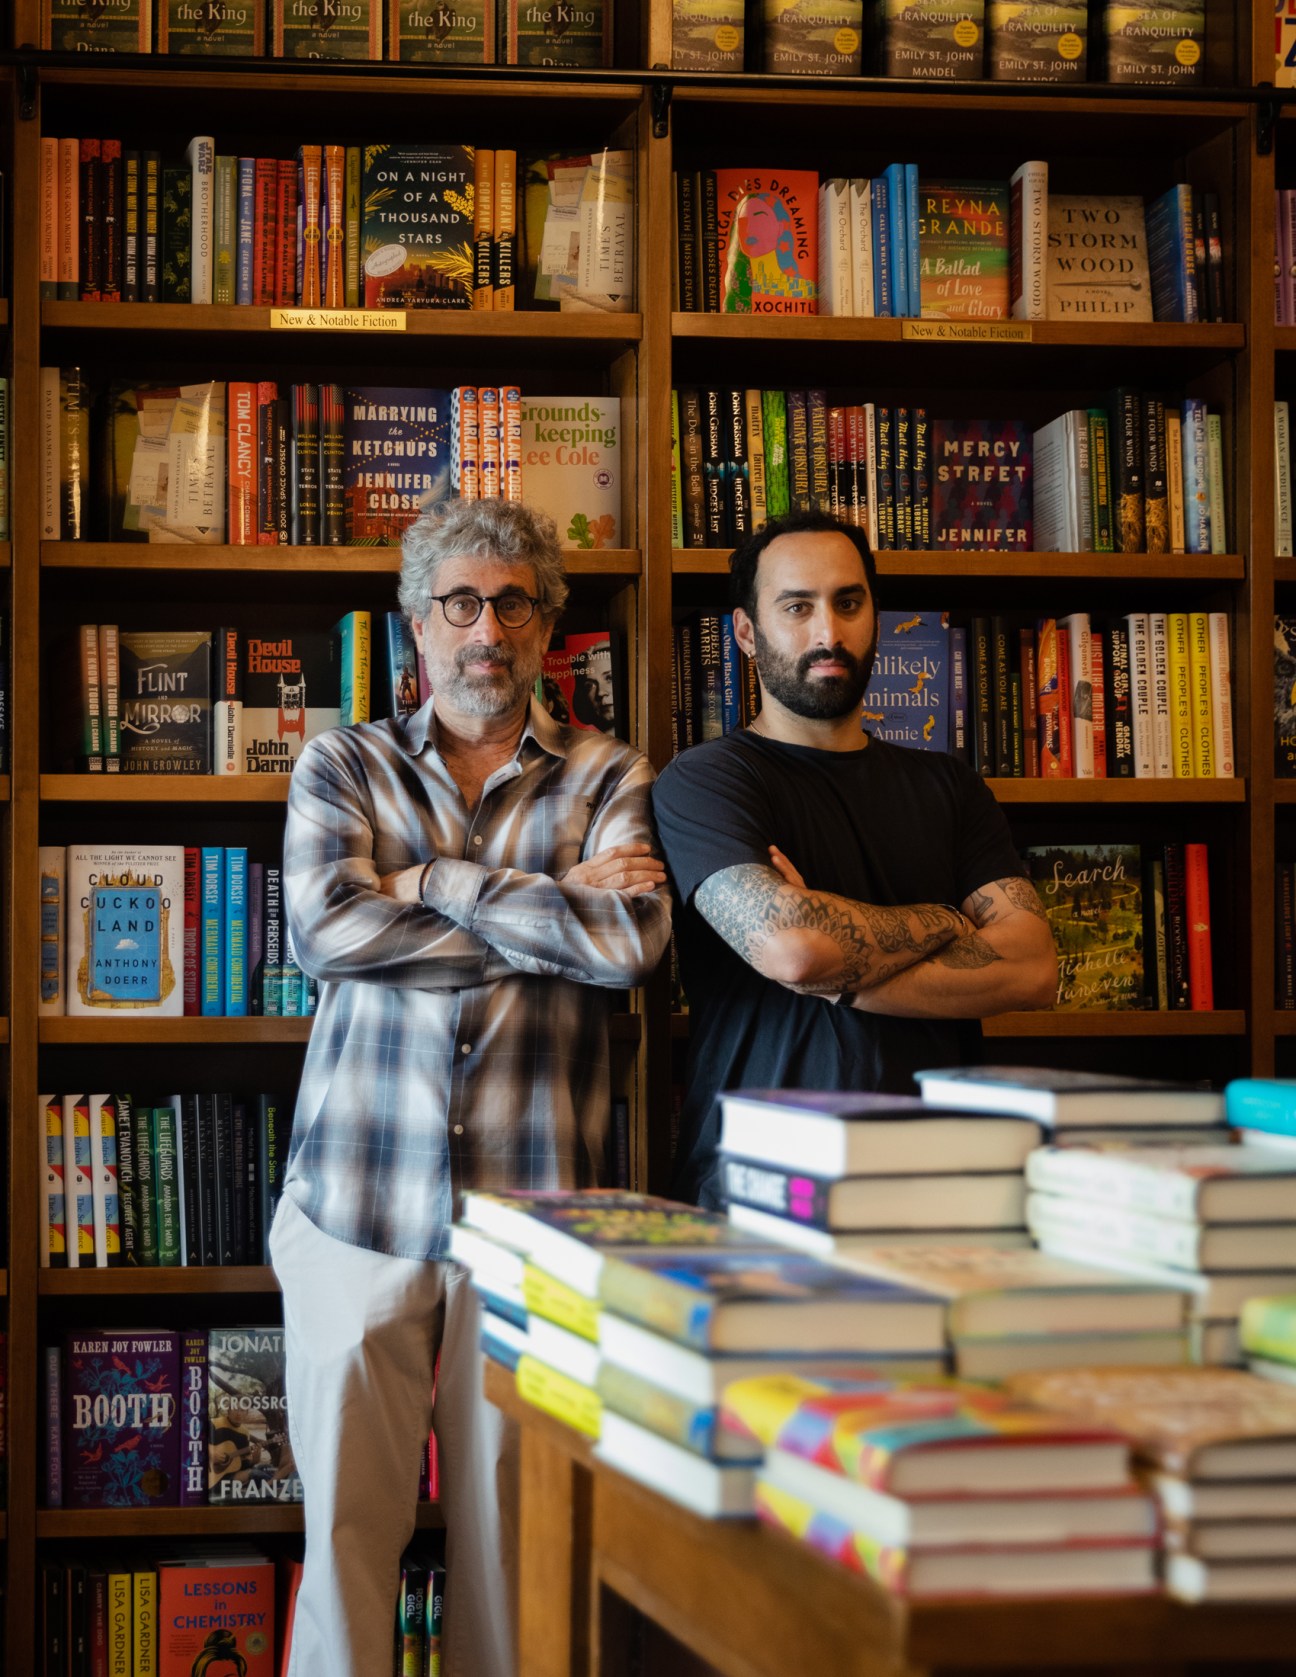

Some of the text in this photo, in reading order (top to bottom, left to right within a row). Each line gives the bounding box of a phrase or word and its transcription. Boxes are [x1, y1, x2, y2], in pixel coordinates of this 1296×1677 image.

[178, 3, 247, 26] the King
[898, 12, 973, 23] TRANQUILITY
[1022, 6, 1059, 17] SEA OF
[408, 11, 476, 33] the King
[1002, 22, 1077, 33] TRANQUILITY
[204, 34, 225, 43] novel
[895, 51, 974, 61] EMILY ST. JOHN
[912, 67, 956, 77] MANDEL
[198, 142, 206, 175] WARS
[205, 142, 213, 175] STAR
[376, 171, 466, 183] ON A NIGHT
[403, 191, 439, 203] OF A
[927, 198, 1000, 216] REYNA
[200, 181, 208, 257] BROTHERHOOD
[379, 212, 460, 224] THOUSAND
[718, 209, 732, 251] OLGA
[770, 179, 809, 260] DREAMING
[1062, 208, 1120, 224] TWO
[859, 202, 869, 252] The Orchard
[918, 219, 1004, 237] GRANDE
[398, 233, 442, 244] STARS
[1048, 233, 1137, 249] STORM
[614, 215, 625, 283] BETRAYAL
[919, 259, 981, 276] A Ballad
[1056, 257, 1134, 273] WOOD
[937, 279, 982, 297] of Love
[754, 301, 814, 313] XOCHITL
[946, 300, 1003, 320] and Glory
[1060, 300, 1135, 314] PHILIP
[280, 313, 399, 328] New & Notable Fiction
[910, 325, 1024, 339] New & Notable Fiction
[353, 405, 437, 422] MARRYING
[388, 427, 403, 436] the
[708, 392, 720, 458] JOHN GRISHAM
[237, 392, 252, 478] TOM CLANCY
[535, 423, 617, 448] keeping
[1148, 401, 1157, 472] THE FOUR WINDS
[352, 440, 437, 457] KETCHUPS
[914, 423, 927, 471] Matt Haig
[944, 440, 1020, 457] MERCY
[523, 446, 600, 466] ee Cole
[751, 405, 765, 508] matrix lauren groff
[356, 472, 432, 489] JENNIFER
[937, 465, 1026, 482] STREET
[370, 493, 420, 509] CLOSE
[709, 479, 721, 533] JUDGE'S LIST
[913, 504, 921, 535] LIBRARY
[937, 528, 1027, 543] JENNIFER
[247, 639, 293, 657] Devil
[1079, 631, 1089, 677] Gilgamesh
[247, 657, 301, 674] House
[546, 651, 611, 667] Trouble with
[1111, 630, 1122, 698] SUPPORT GROUP
[1154, 618, 1167, 715] THE GOLDEN COUPLE
[543, 667, 595, 680] Happiness
[871, 656, 941, 680] nlikely
[1120, 643, 1129, 693] FINAL GIRL
[137, 663, 188, 695] FLINT
[862, 688, 940, 708] nimals
[1196, 617, 1210, 775] OTHER PEOPLE'S CLOTHES
[120, 702, 202, 731] MIRROR
[873, 726, 919, 741] Annie
[1115, 721, 1124, 758] HENDRIX
[1122, 725, 1131, 755] GRADY
[246, 739, 289, 756] John
[123, 759, 202, 771] JOHN CROWLEY
[246, 756, 297, 773] Darni
[89, 874, 163, 887] CLOUD
[1046, 854, 1127, 894] Search
[80, 897, 171, 910] CUCKOO
[97, 920, 154, 933] LAND
[231, 856, 243, 1004] TIM DORSEY MERMAID CONFIDENTIAL
[96, 959, 157, 968] ANTHONY
[105, 976, 148, 985] DOERR
[118, 1100, 132, 1182] JANET EVANOVICH
[159, 1116, 172, 1181] THE LIFEGUARDS
[267, 1107, 277, 1183] Beneath the Stairs
[73, 1340, 172, 1354] KAREN JOY FOWLER
[72, 1393, 173, 1429] BOOTH
[219, 1396, 288, 1411] CROSSRO
[220, 1480, 304, 1499] FRANZE
[184, 1581, 257, 1597] LESSONS
[214, 1599, 227, 1610] in
[139, 1578, 151, 1673] LISA GARDNER
[173, 1612, 266, 1629] CHEMISTRY
